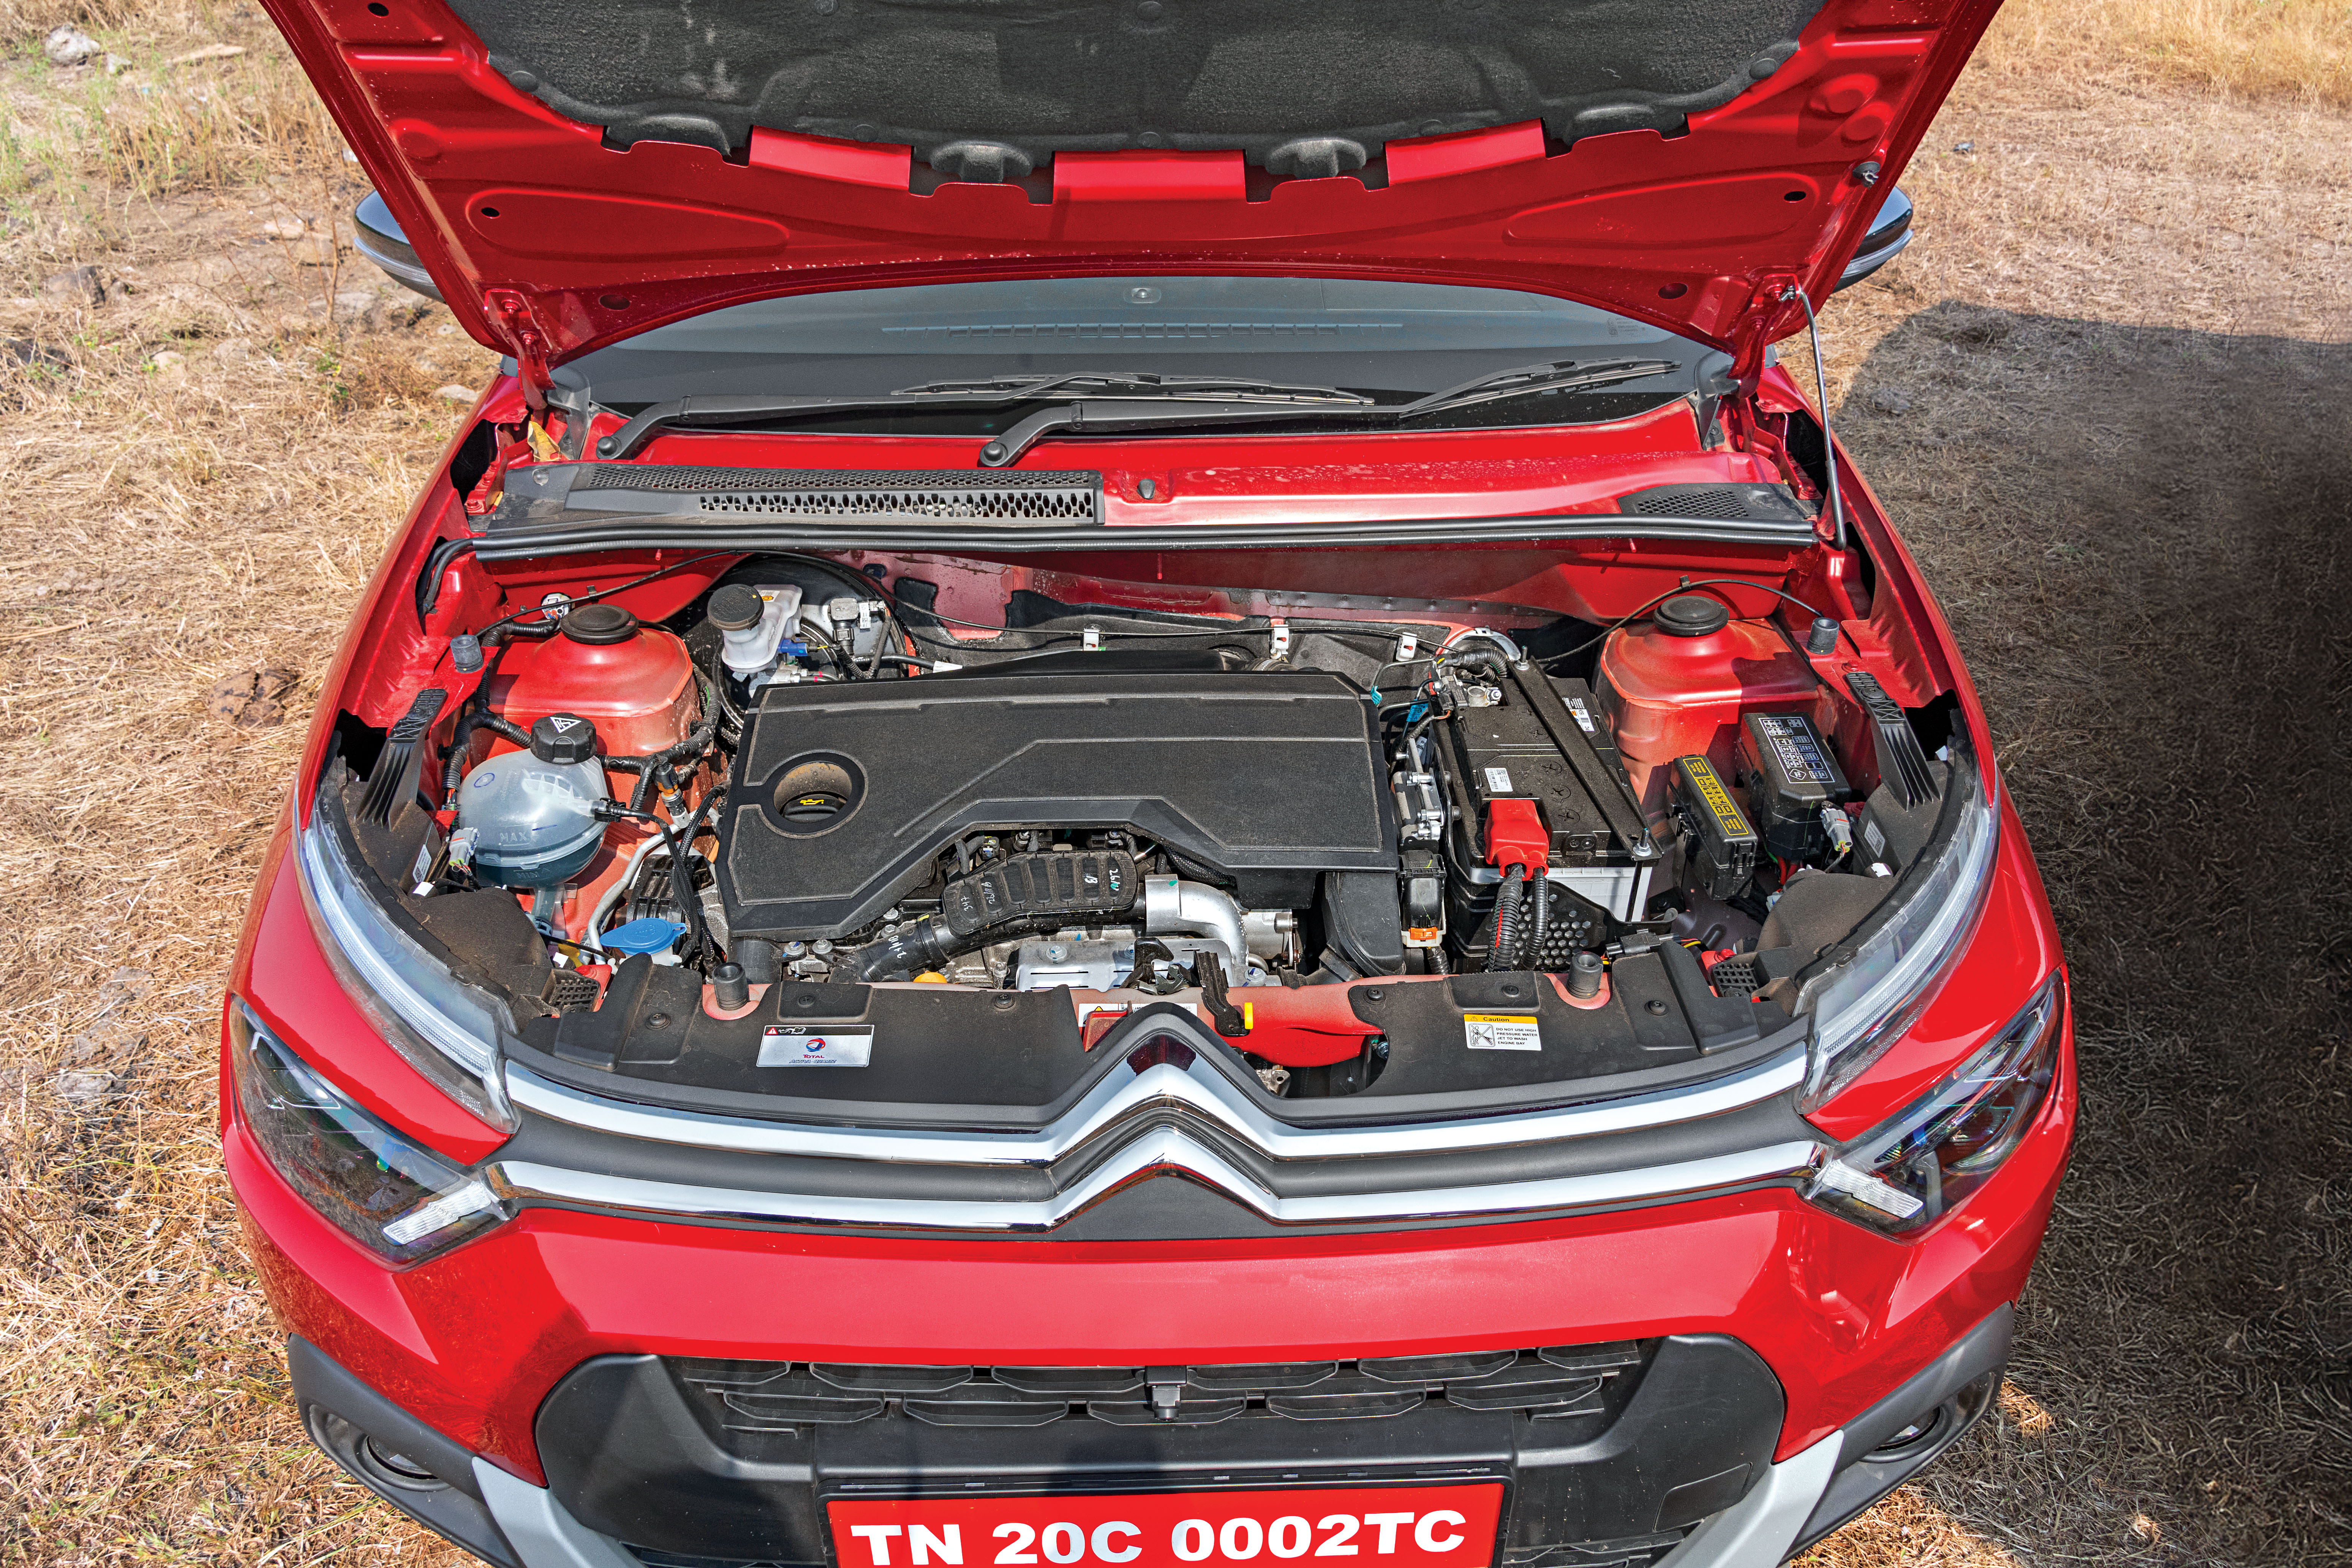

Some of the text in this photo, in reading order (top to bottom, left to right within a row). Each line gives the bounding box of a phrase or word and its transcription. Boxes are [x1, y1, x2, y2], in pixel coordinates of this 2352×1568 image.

[499, 831, 528, 842] MAX
[850, 1510, 1466, 1566] TN 20C 0002TC
